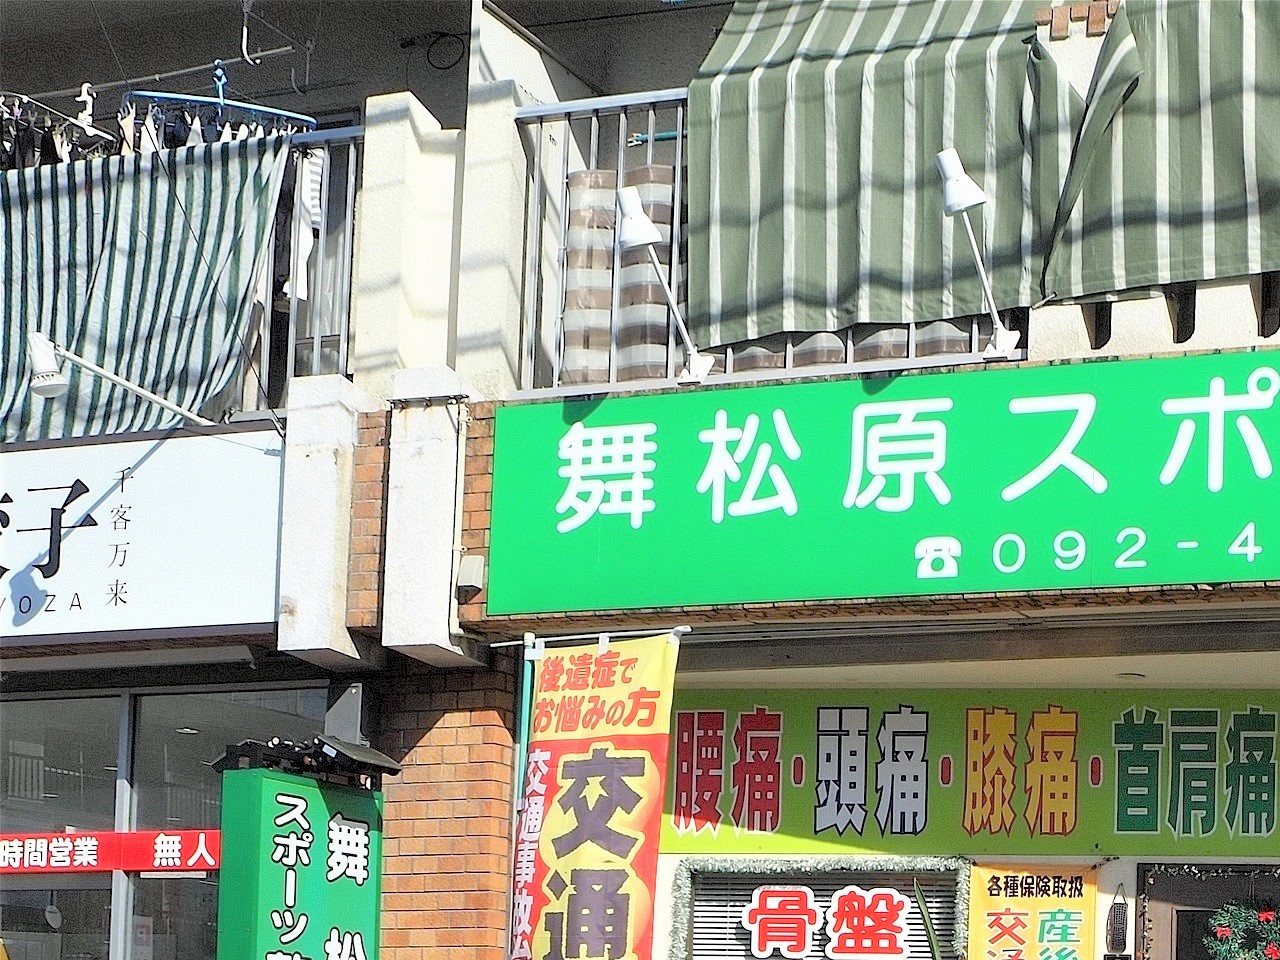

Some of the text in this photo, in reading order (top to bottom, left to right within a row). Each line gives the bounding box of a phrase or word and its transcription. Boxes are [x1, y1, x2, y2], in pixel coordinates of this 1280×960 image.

[106, 466, 134, 607] 千客万来
[539, 651, 638, 692] 後遺症で
[532, 687, 660, 733] お悩みの方
[987, 874, 1084, 899] 各種保険取扱
[749, 890, 905, 954] 骨盤
